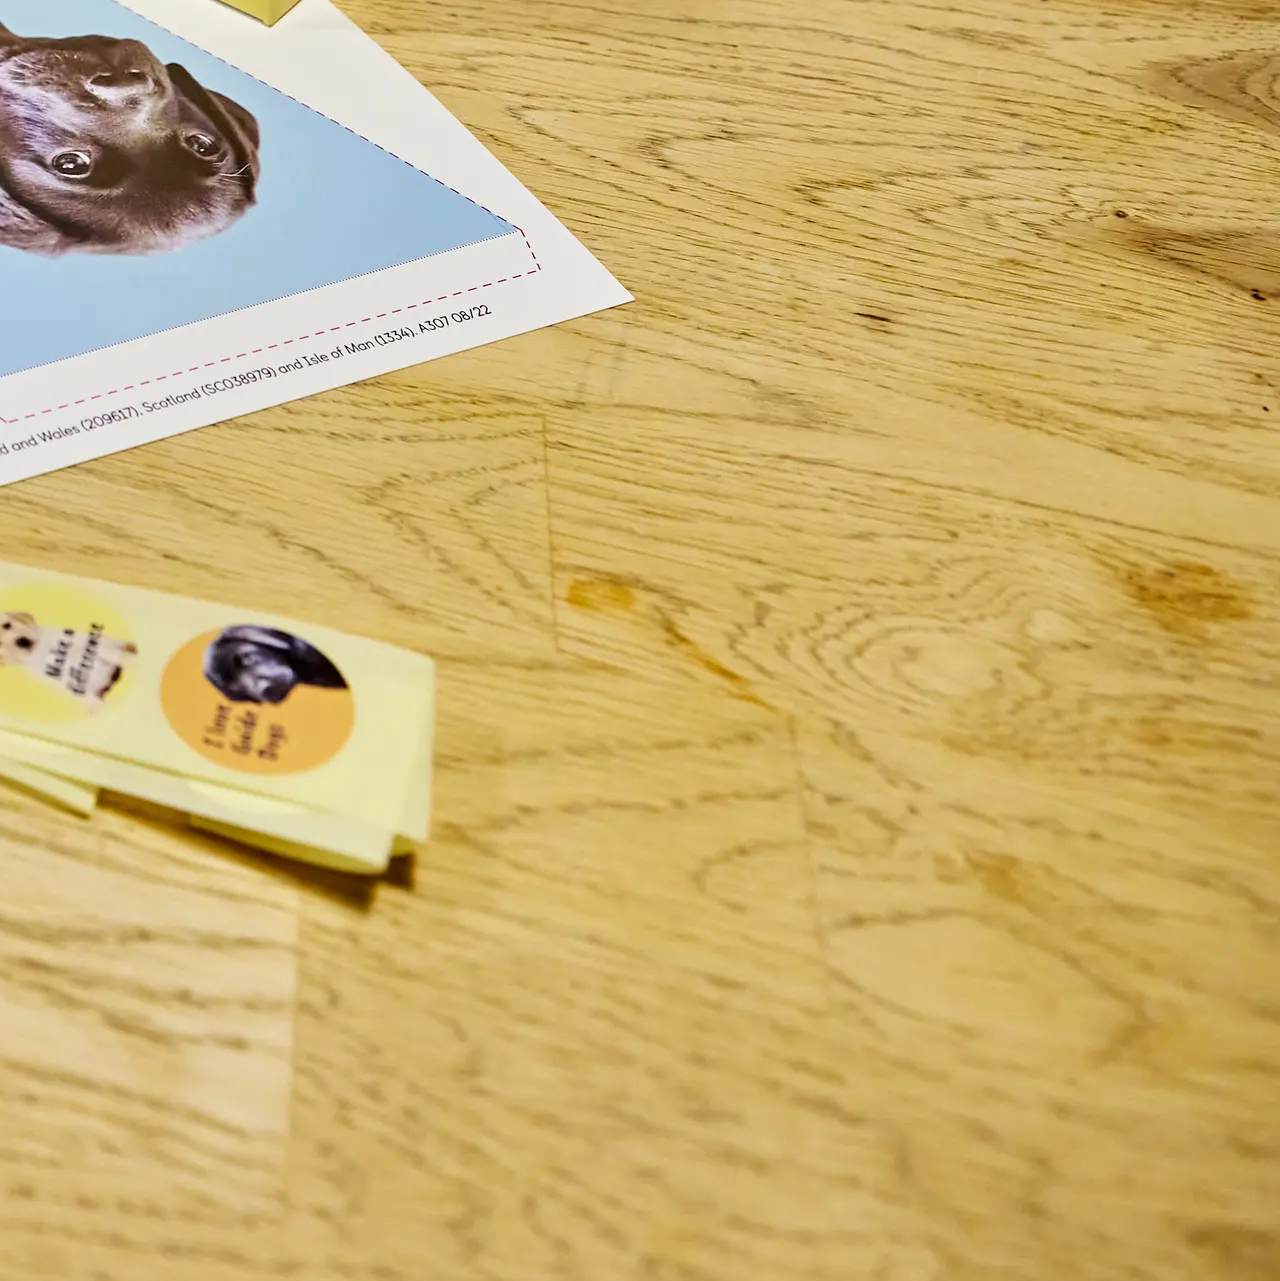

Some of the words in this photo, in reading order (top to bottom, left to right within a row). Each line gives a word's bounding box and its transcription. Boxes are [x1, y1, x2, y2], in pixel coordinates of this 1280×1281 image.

[142, 389, 201, 413] Scotland
[201, 366, 277, 396] (SC038979)
[279, 358, 303, 374] and
[303, 352, 329, 366] Isle
[331, 346, 344, 359] of
[345, 338, 375, 354] Man
[374, 326, 418, 349] (1334).
[418, 316, 450, 333] A307
[451, 304, 492, 322] 08/22
[12, 436, 38, 452] and
[39, 424, 80, 445] Wales
[80, 406, 143, 432] (209617),
